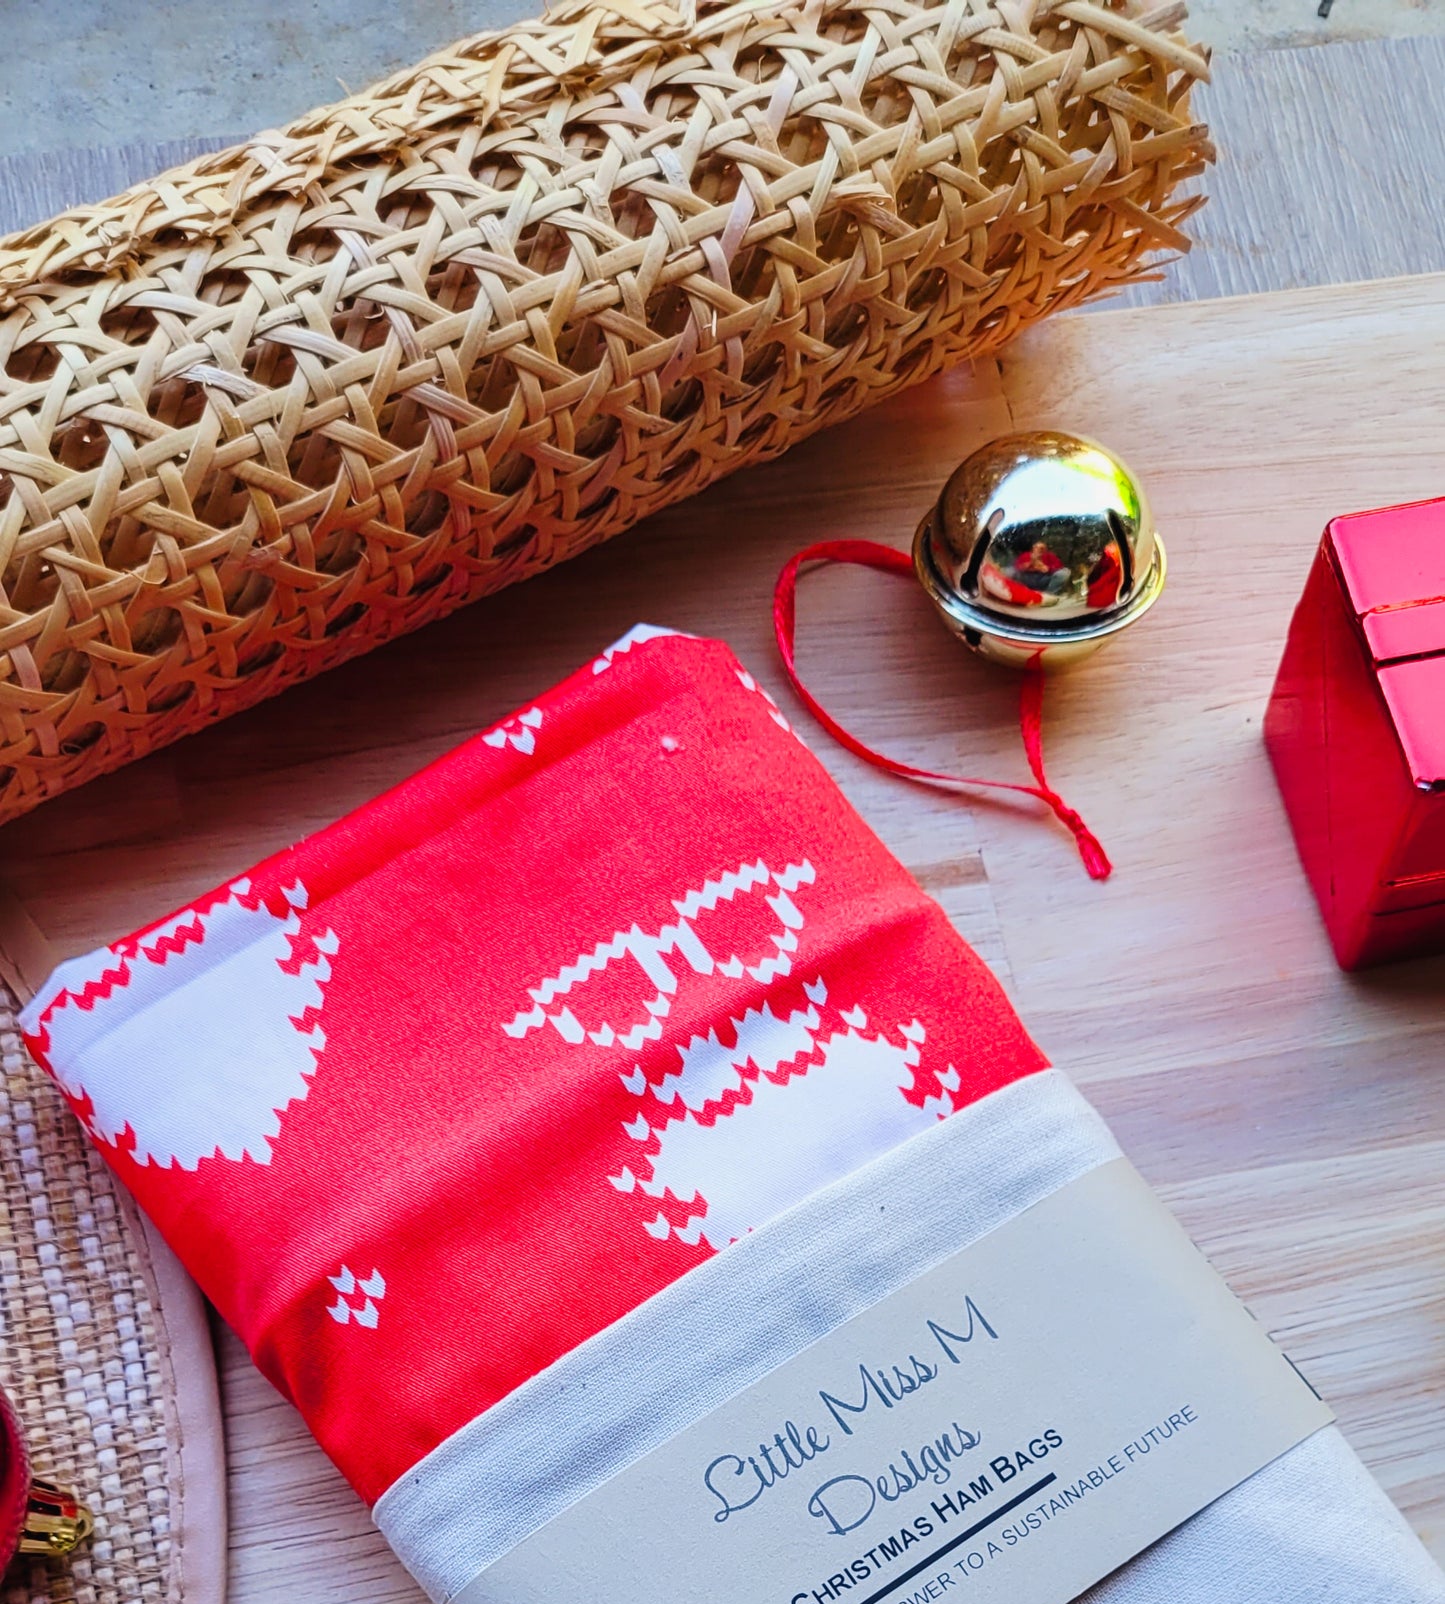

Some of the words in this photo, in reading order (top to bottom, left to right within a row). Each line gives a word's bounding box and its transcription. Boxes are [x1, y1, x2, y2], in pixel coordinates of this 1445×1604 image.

[704, 1420, 830, 1522] Little
[819, 1355, 938, 1435] Miss
[926, 1295, 999, 1365] M
[807, 1422, 981, 1536] Designs
[930, 1475, 994, 1527] HAM
[991, 1429, 1064, 1484] BAGS
[954, 1552, 985, 1578] TO
[986, 1540, 1004, 1560] A
[1001, 1454, 1126, 1546] SUSTAINABLE
[1123, 1404, 1199, 1463] FUTURE
